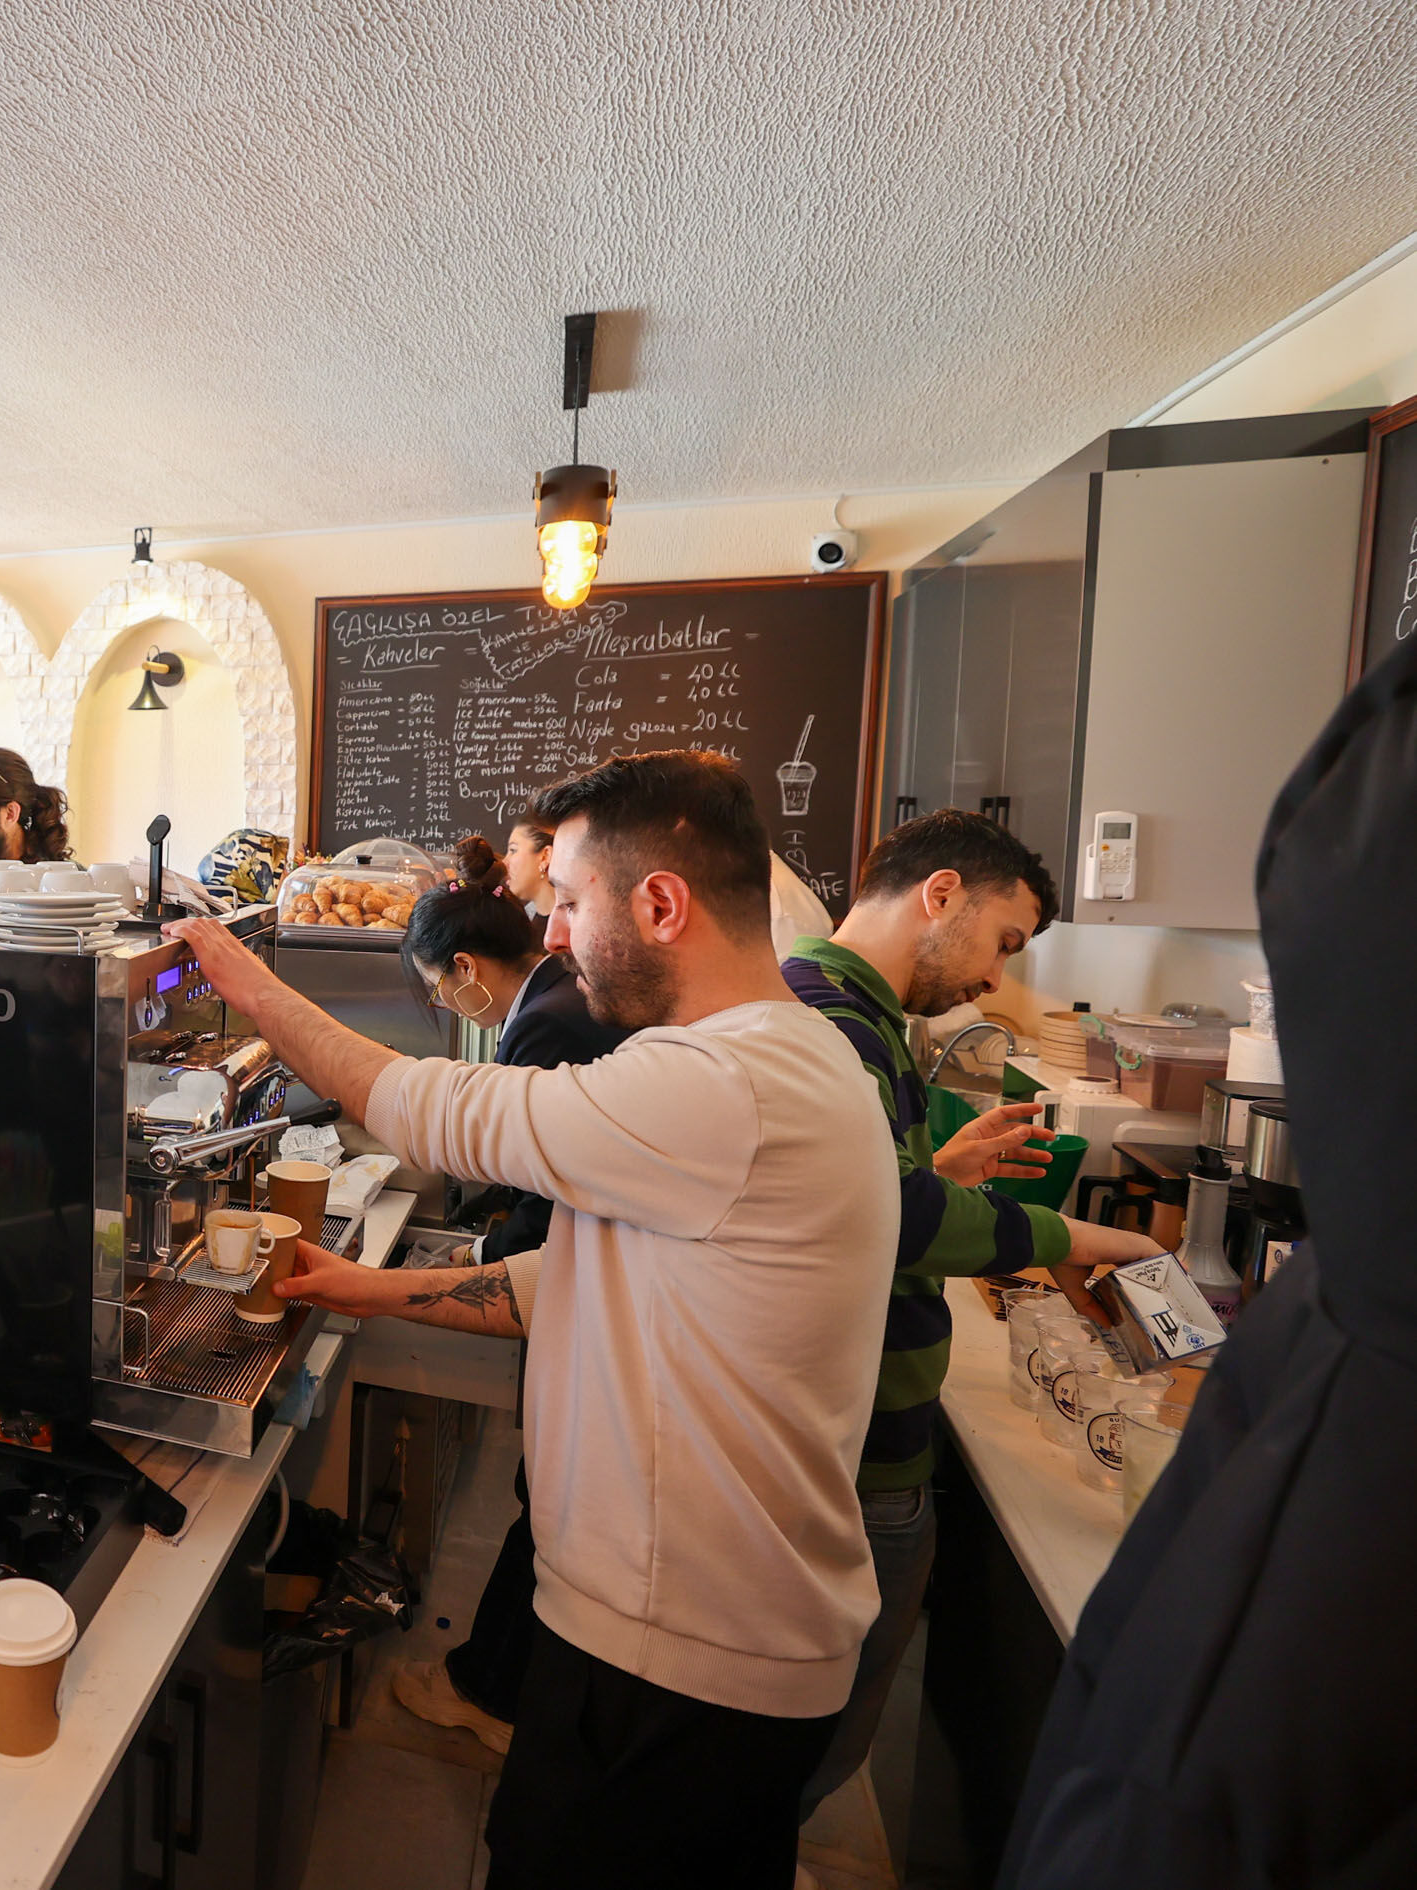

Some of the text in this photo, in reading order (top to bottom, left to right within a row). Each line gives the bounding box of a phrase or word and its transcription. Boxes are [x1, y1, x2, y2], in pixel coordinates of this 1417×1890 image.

[584, 614, 731, 658] Meşrubatlar
[363, 638, 445, 668] Kahveler
[575, 665, 618, 687] Cola
[573, 692, 623, 714] Fanta
[570, 716, 615, 744] Niğde
[692, 709, 717, 732] 20
[564, 745, 598, 767] Sade
